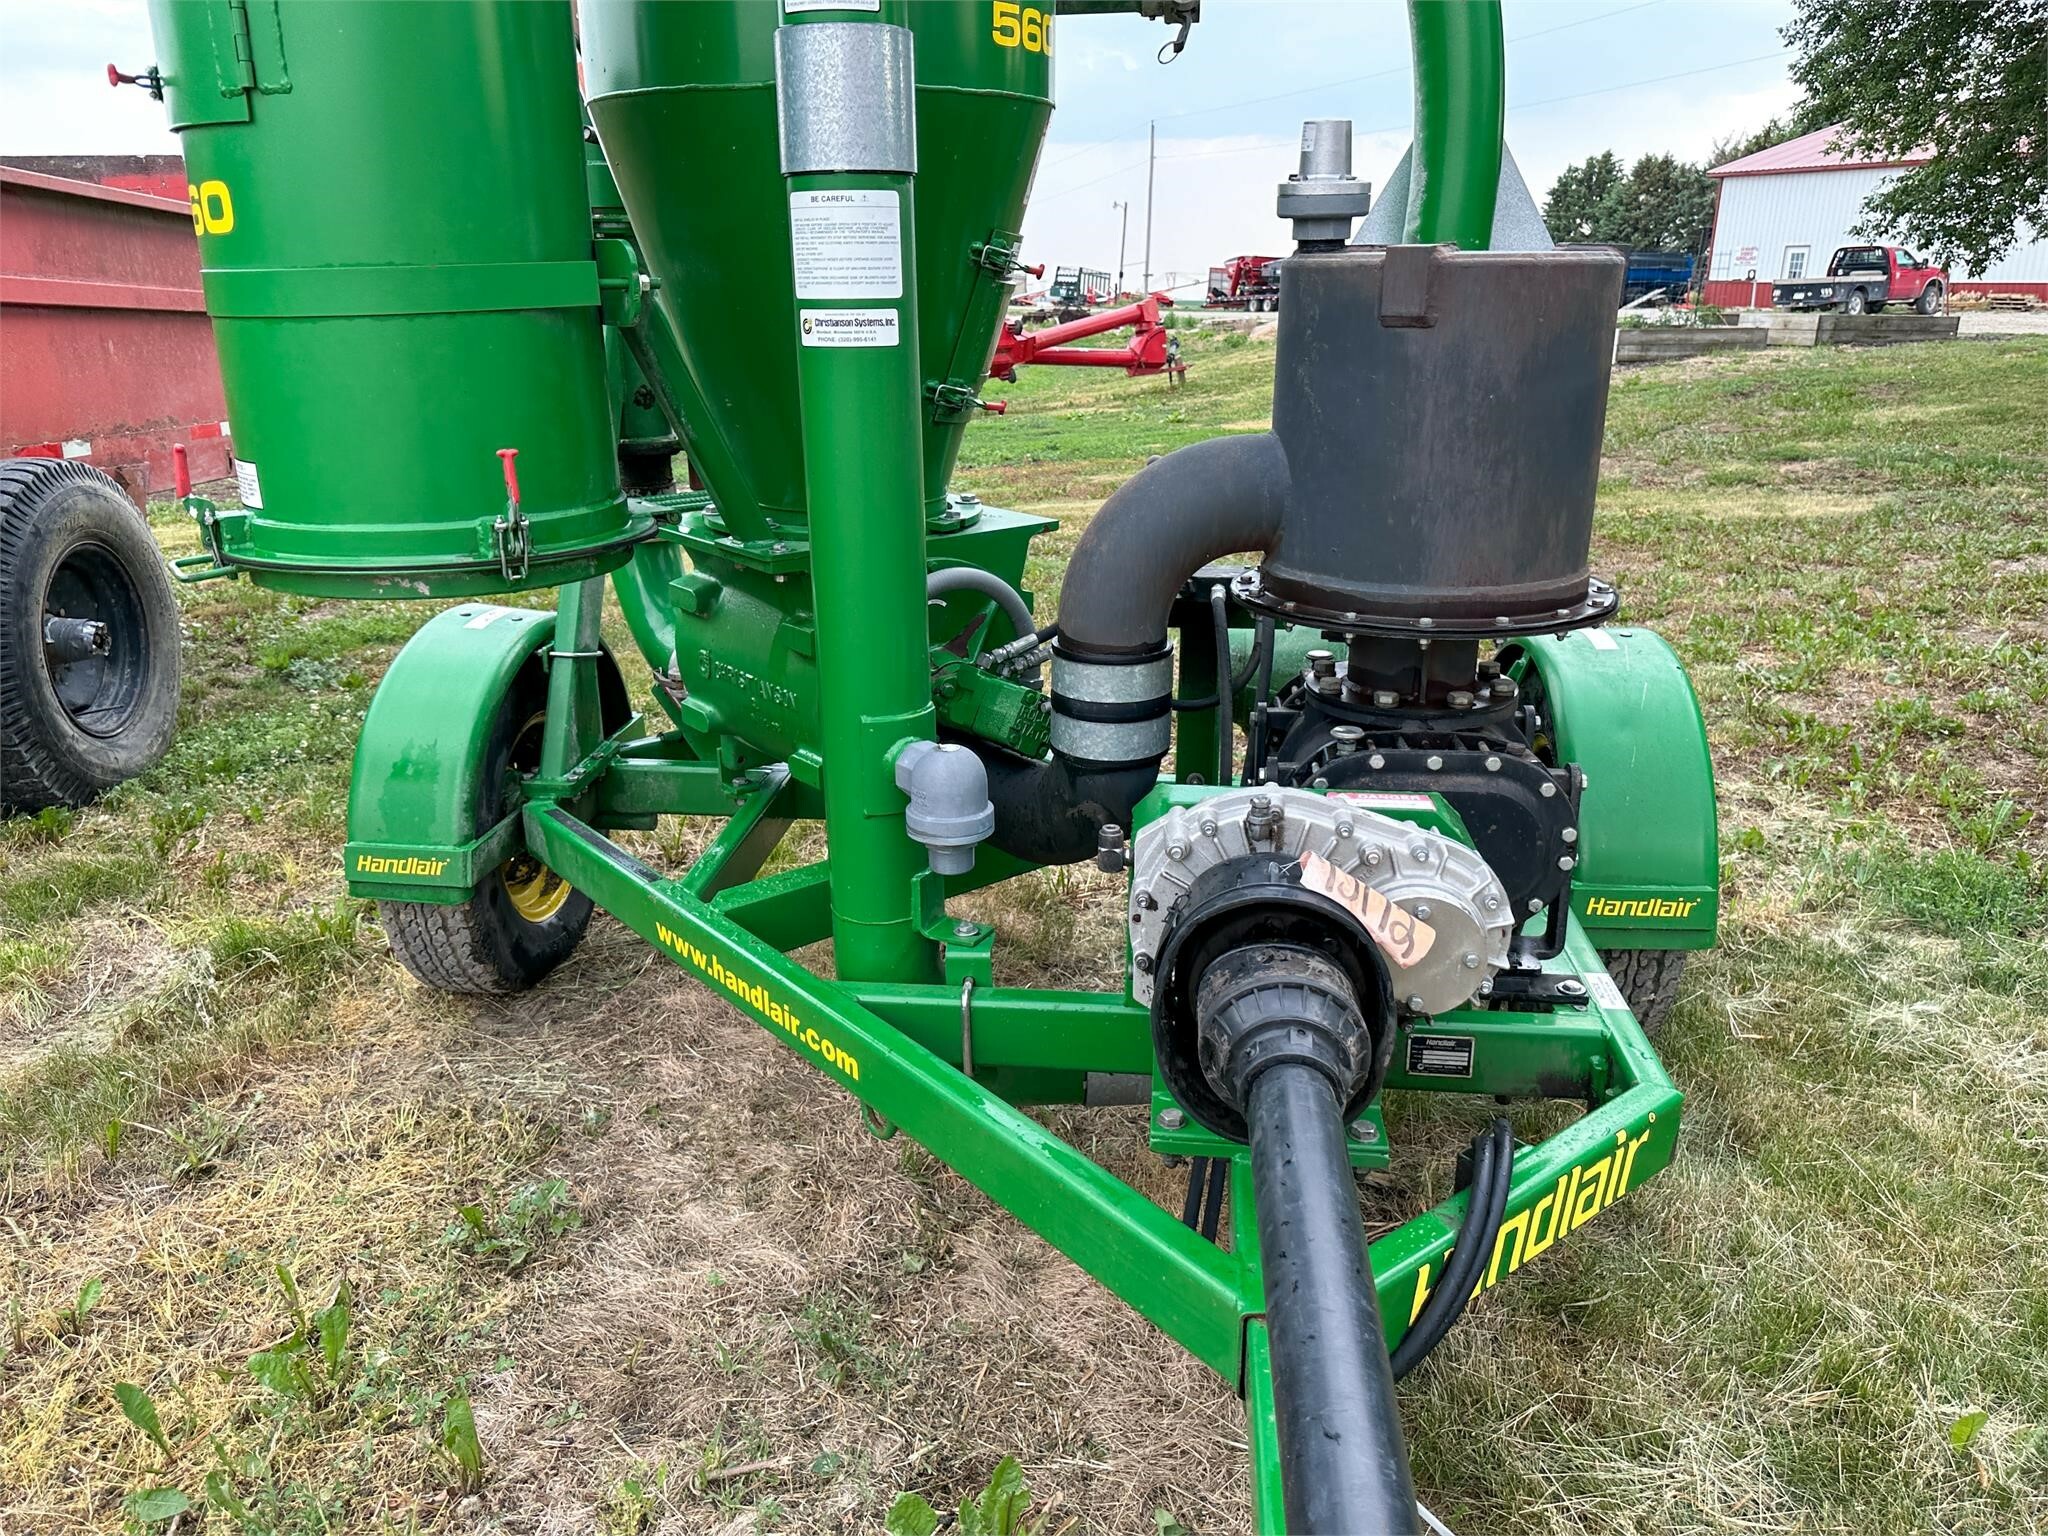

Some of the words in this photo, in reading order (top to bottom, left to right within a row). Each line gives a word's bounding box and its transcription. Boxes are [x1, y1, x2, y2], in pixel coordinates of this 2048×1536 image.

[810, 195, 820, 203] BE
[821, 195, 855, 203] CAREFUL
[815, 318, 853, 327] Christianson
[854, 318, 885, 328] Systems,
[886, 318, 896, 327] Inc.
[357, 854, 448, 876] Handlair
[1585, 897, 1700, 918] Handlair
[655, 921, 860, 1081] www.handlair.com
